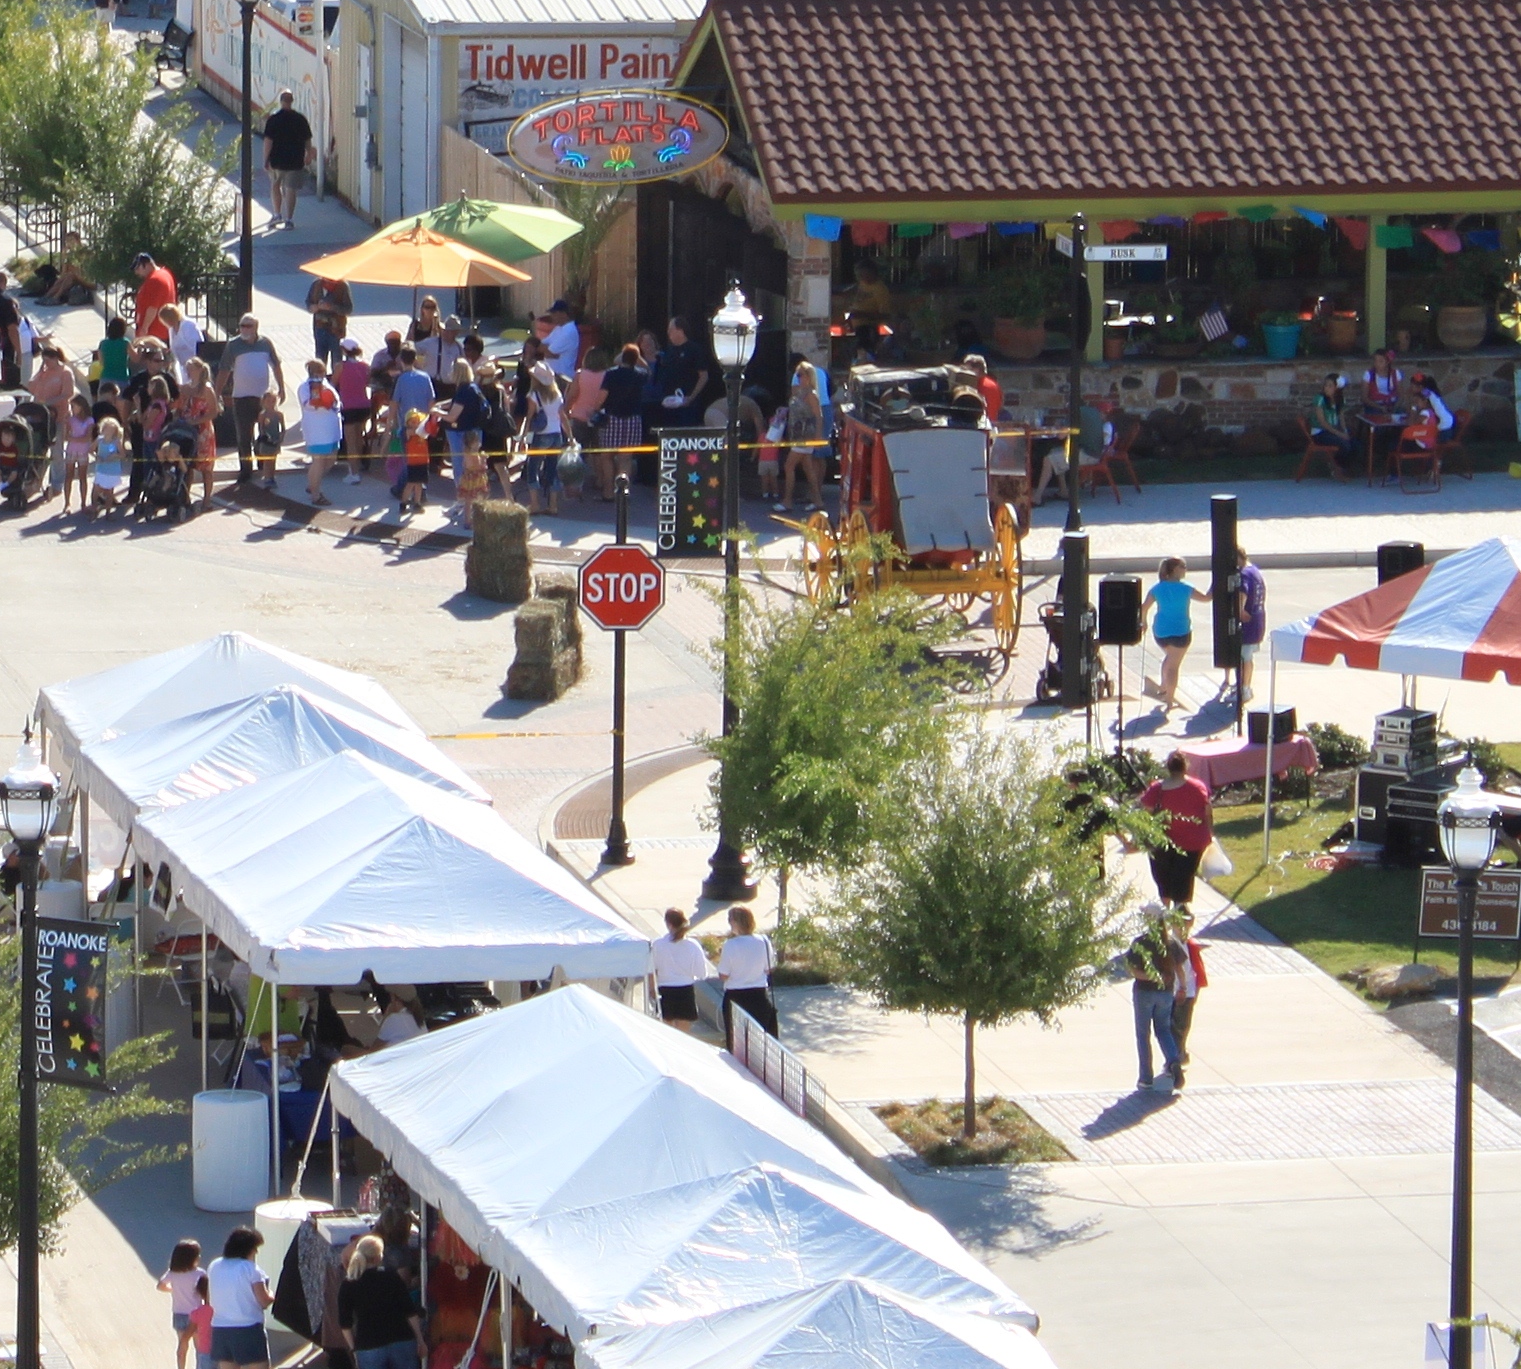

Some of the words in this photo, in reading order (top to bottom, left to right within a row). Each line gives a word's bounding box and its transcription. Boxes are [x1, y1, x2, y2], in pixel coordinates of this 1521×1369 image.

[465, 43, 586, 81] Tidwell
[599, 42, 680, 80] Pain
[533, 100, 701, 141] TORTILLA
[579, 114, 666, 145] FLATS
[1110, 248, 1136, 259] RUSK
[661, 436, 725, 451] ROANOKE
[658, 450, 678, 550] CELEBRATE
[586, 572, 658, 603] STOP
[1425, 896, 1445, 905] Faith
[1426, 878, 1445, 889] The
[1491, 880, 1519, 892] Touch
[38, 929, 107, 953] ROANOKE
[35, 945, 57, 1073] CELEBRATE
